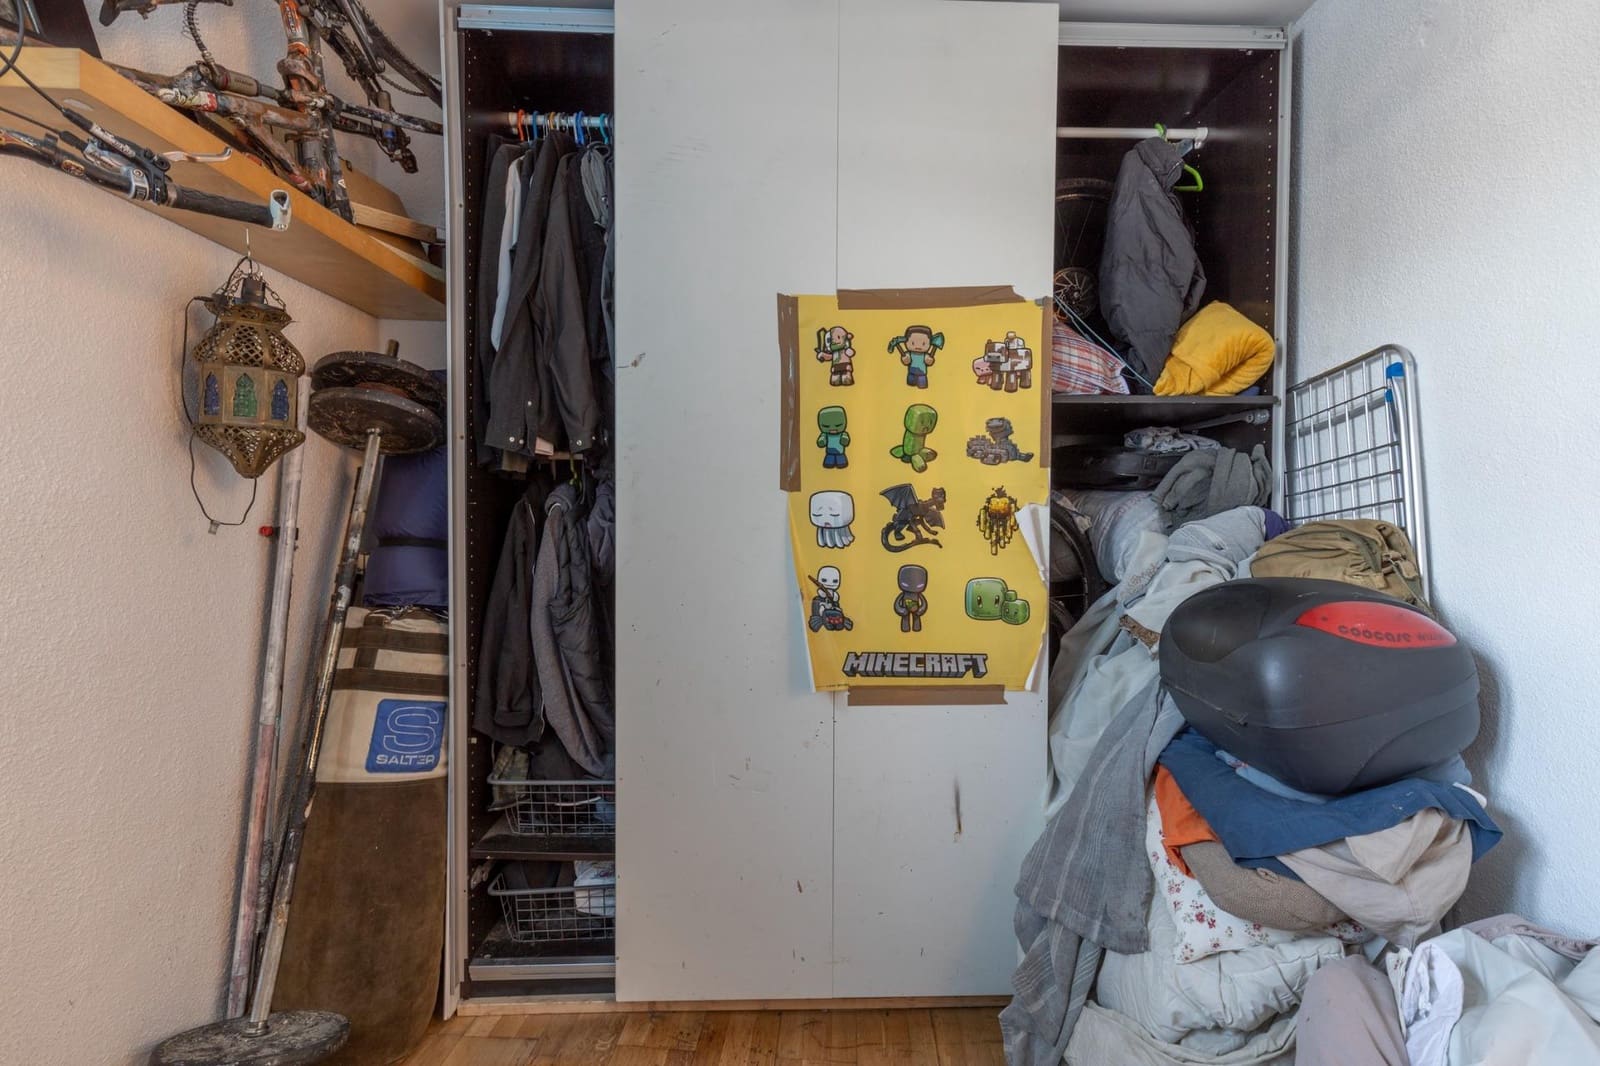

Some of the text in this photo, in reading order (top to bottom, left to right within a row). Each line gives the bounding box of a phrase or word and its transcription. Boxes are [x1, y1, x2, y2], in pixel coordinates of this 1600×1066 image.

[842, 652, 988, 678] MINECRAFT
[383, 706, 440, 754] S
[375, 754, 436, 766] SALTER
